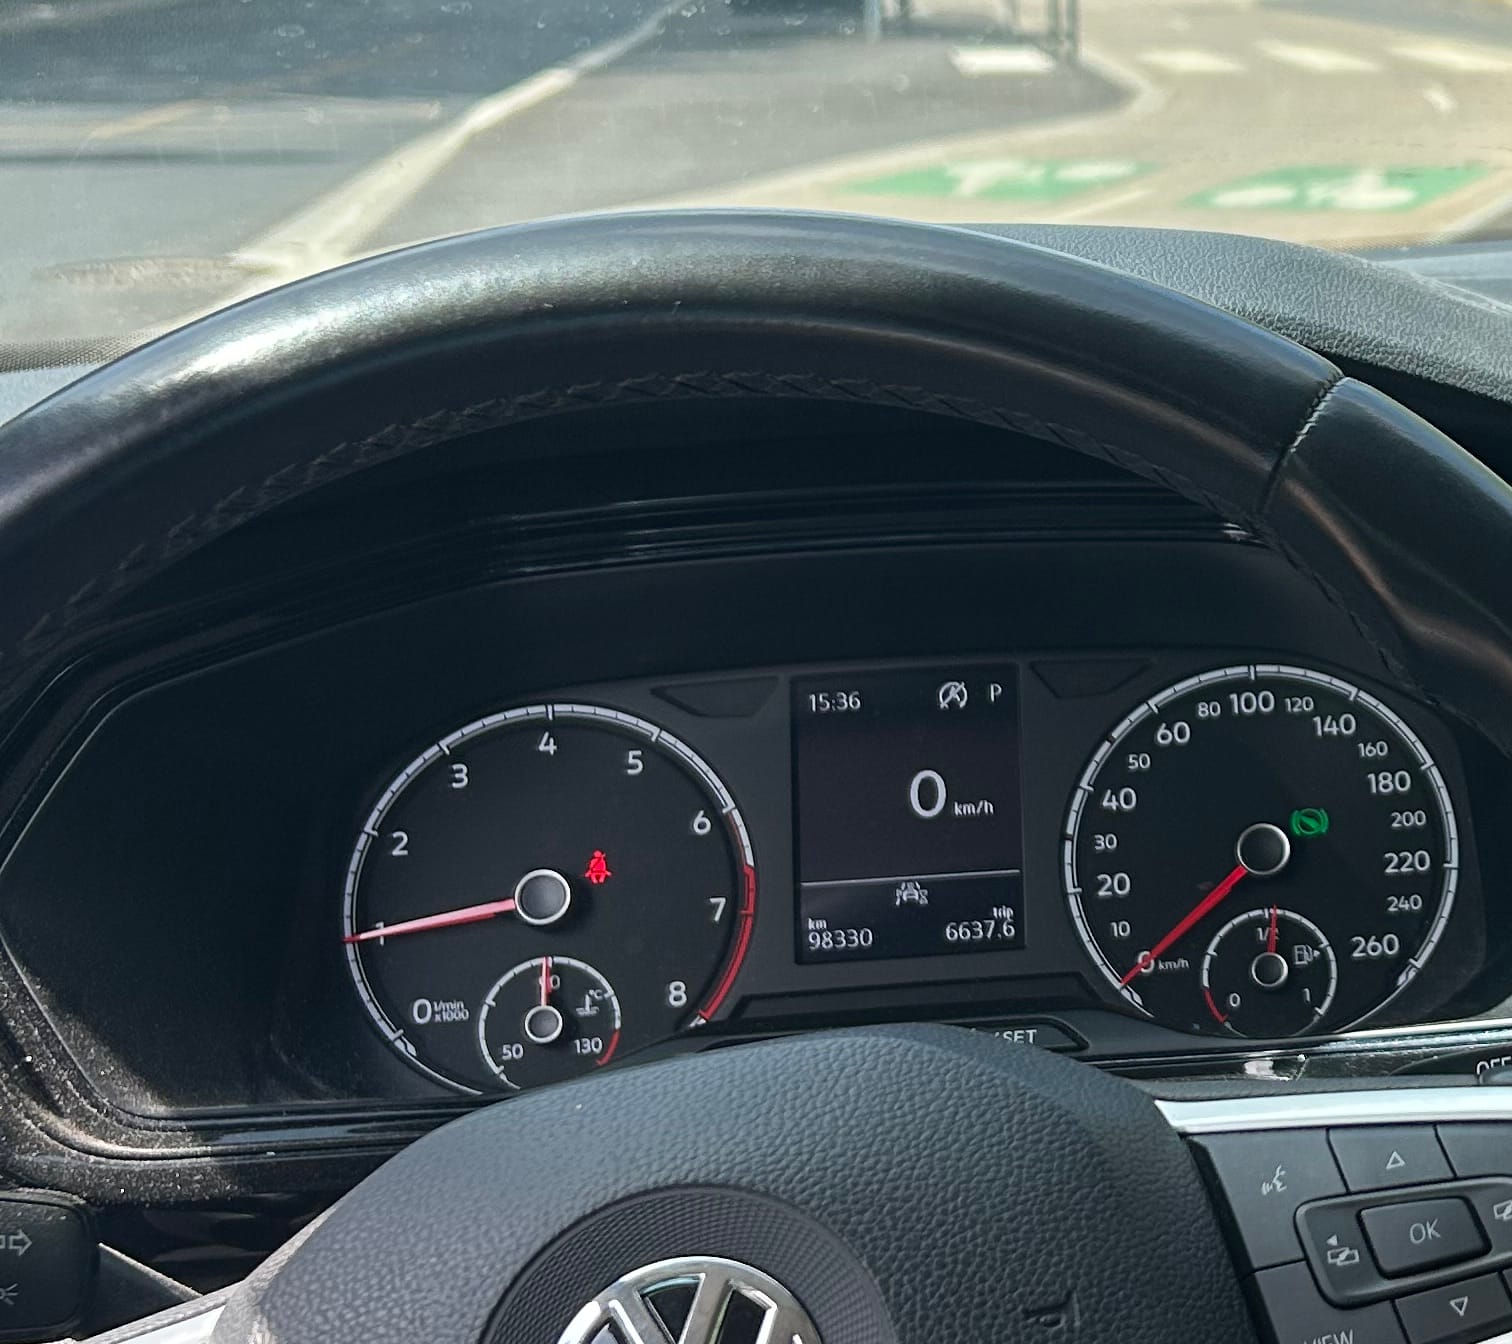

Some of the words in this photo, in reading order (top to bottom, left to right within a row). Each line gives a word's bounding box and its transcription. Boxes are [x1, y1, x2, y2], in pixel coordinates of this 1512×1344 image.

[808, 691, 861, 712] 15:36
[990, 683, 1003, 702] P
[1230, 690, 1275, 715] 100
[1285, 695, 1314, 713] 120
[1197, 701, 1221, 719] 80
[1156, 721, 1191, 745] 60
[1313, 713, 1356, 737] 140
[538, 732, 557, 754] 4
[1358, 740, 1388, 758] 160
[626, 751, 643, 775] 5
[1128, 753, 1150, 770] 50
[451, 764, 469, 789] 3
[1367, 770, 1411, 794] 180
[910, 769, 947, 819] 0
[953, 799, 994, 817] km/h
[1102, 787, 1137, 811] 40
[693, 811, 712, 835] 6
[1391, 810, 1426, 828] 200
[392, 832, 409, 856] 2
[1095, 834, 1117, 851] 30
[1384, 851, 1430, 874] 220
[1097, 872, 1131, 896] 20
[710, 898, 727, 922] 7
[1387, 894, 1422, 913] 240
[807, 917, 827, 930] km
[808, 927, 873, 950] 98330
[945, 919, 1015, 941] 6637.6
[1110, 920, 1131, 938] 10
[1351, 933, 1399, 958] 260
[1158, 958, 1190, 970] km/h
[668, 982, 687, 1006] 8
[1229, 992, 1241, 1008] 0
[1303, 988, 1311, 1002] 1
[413, 998, 432, 1024] 0
[502, 1044, 524, 1059] 50
[574, 1038, 602, 1054] 130
[1409, 1218, 1441, 1244] OK
